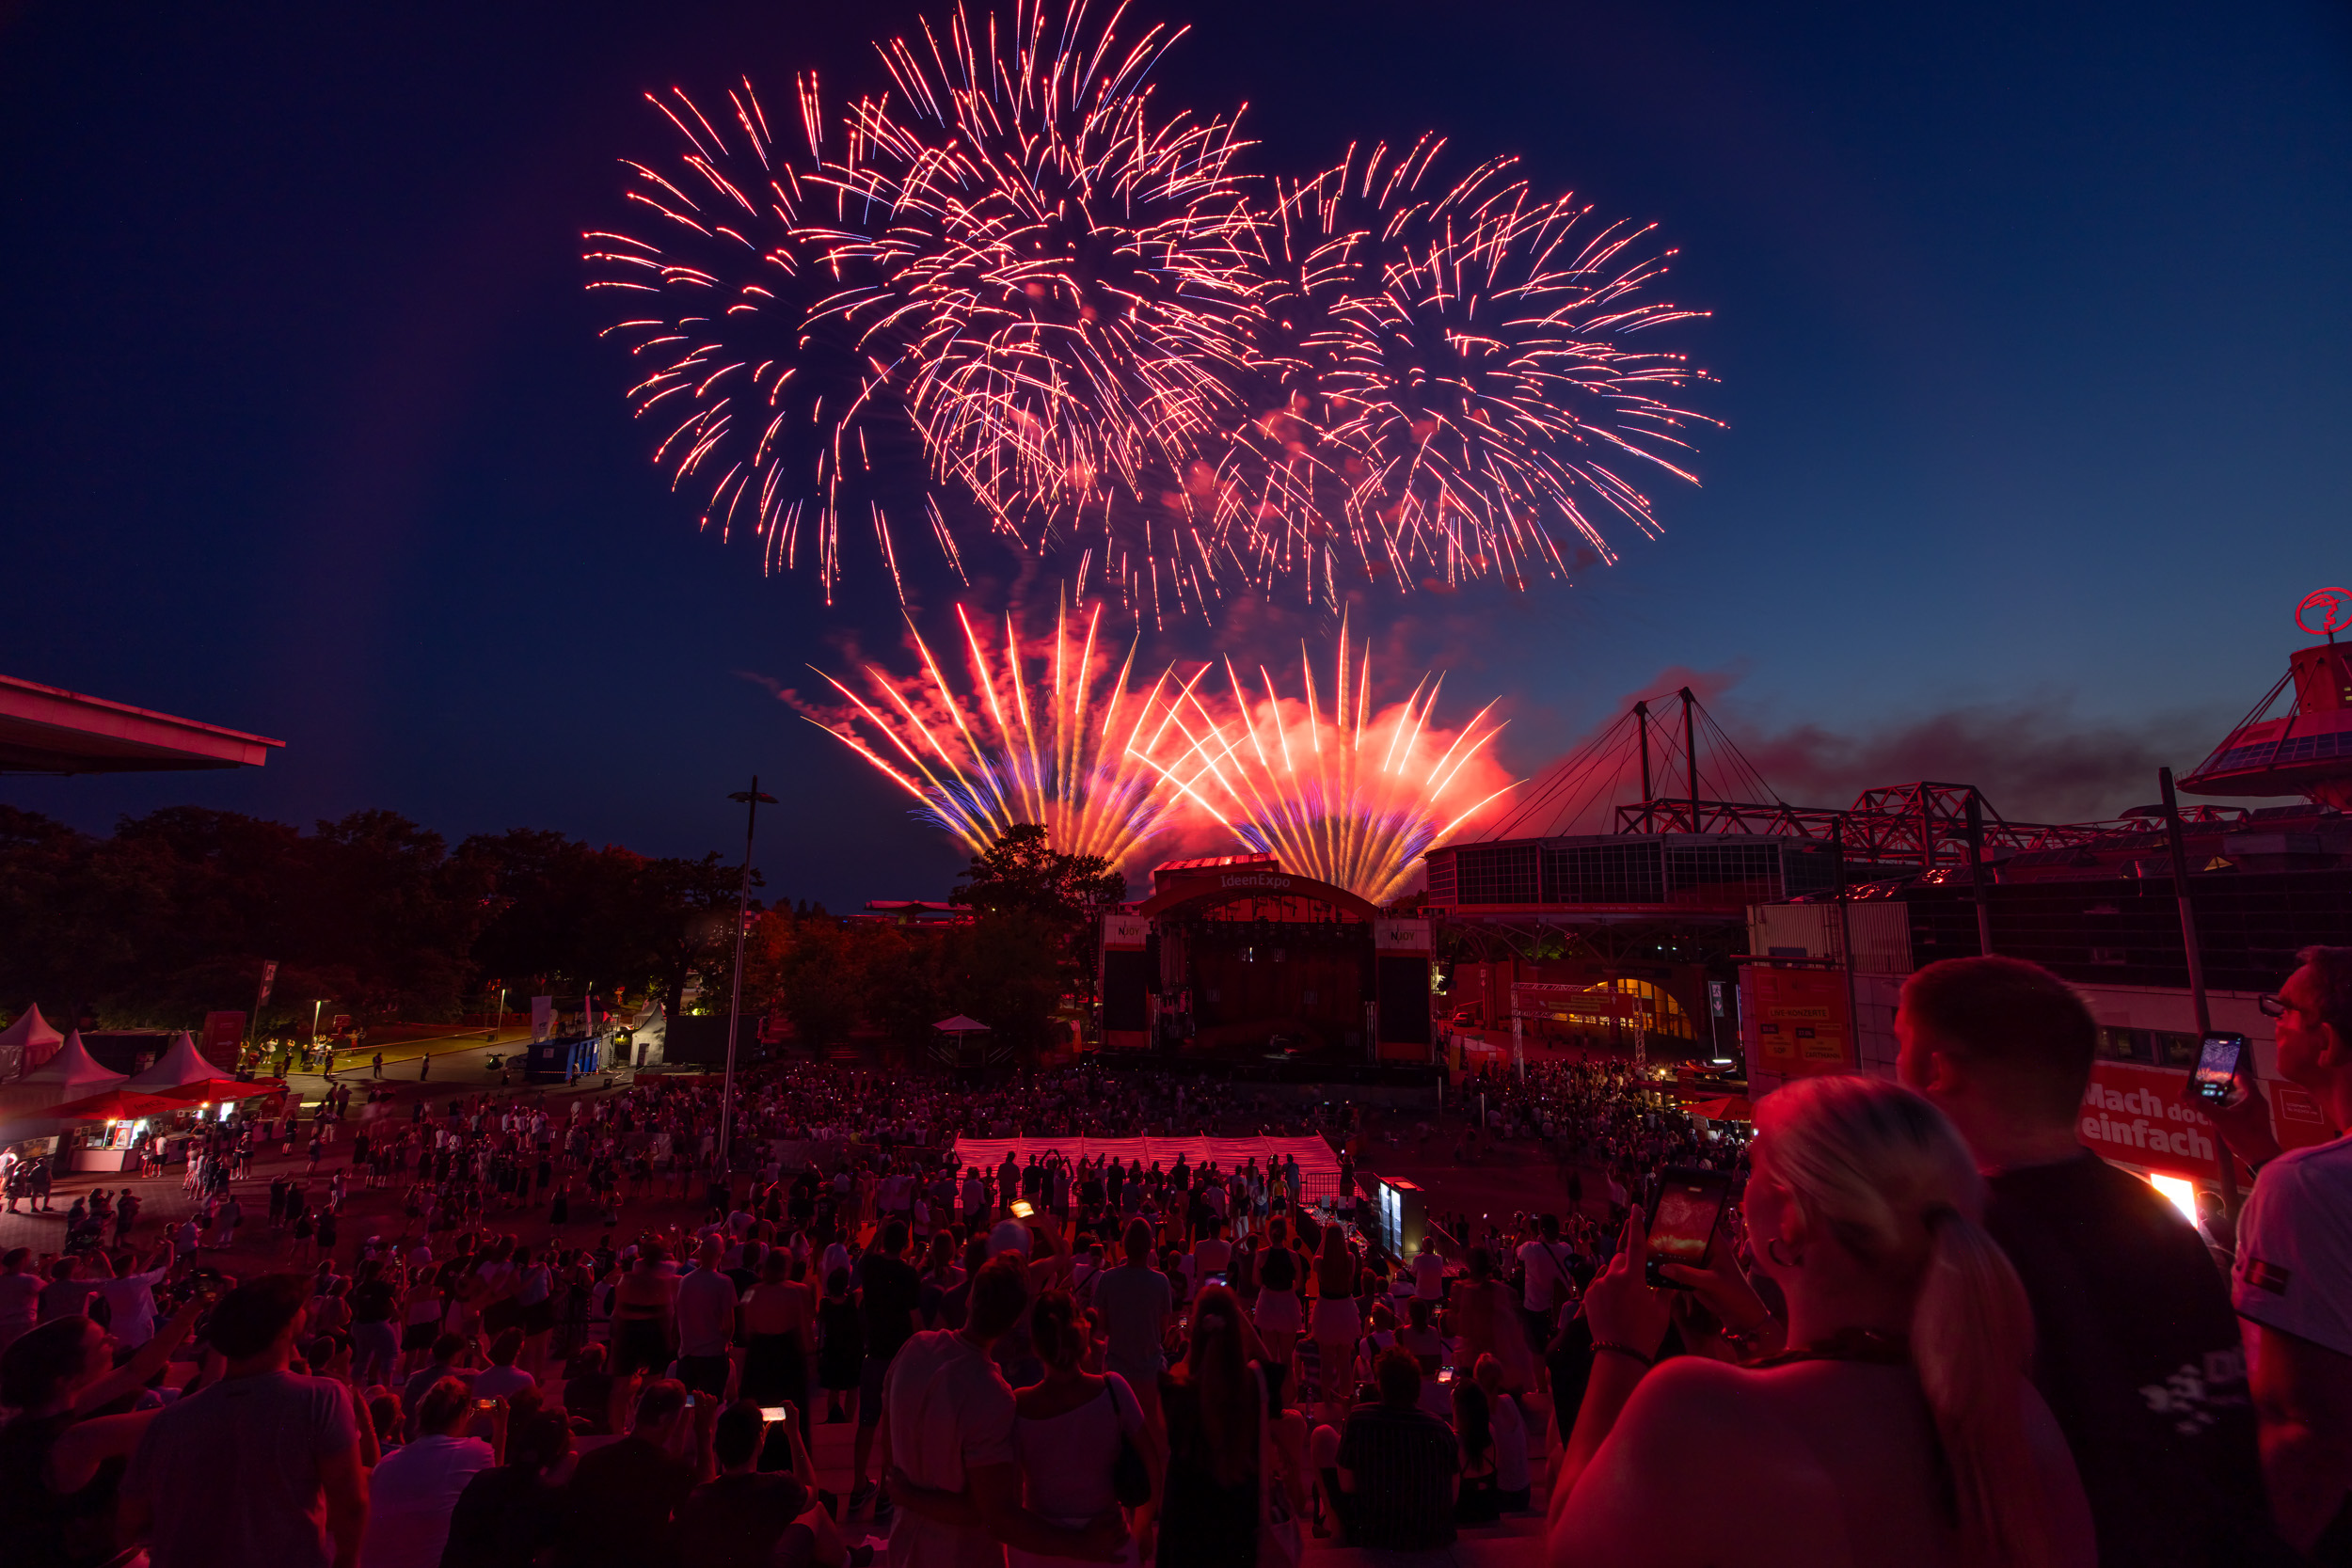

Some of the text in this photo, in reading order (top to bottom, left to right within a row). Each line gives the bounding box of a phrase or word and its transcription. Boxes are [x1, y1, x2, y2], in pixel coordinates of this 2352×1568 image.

[1220, 873, 1291, 889] IdeenExpo
[1770, 1008, 1827, 1017] LIVE-KONZERTE
[2083, 1083, 2213, 1127] Mach doc
[2081, 1113, 2215, 1162] einfach
